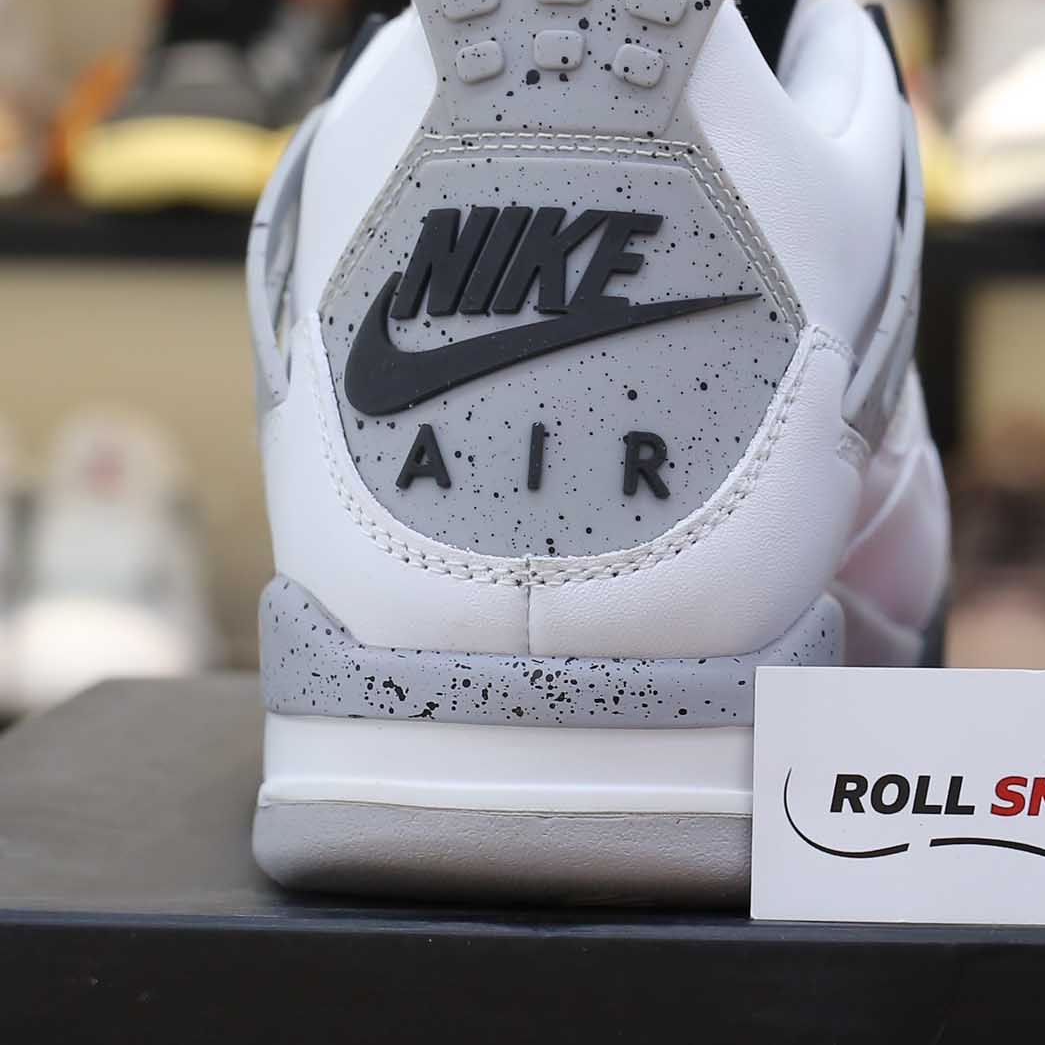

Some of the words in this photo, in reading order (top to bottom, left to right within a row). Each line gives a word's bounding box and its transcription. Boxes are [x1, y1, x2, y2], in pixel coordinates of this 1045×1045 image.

[390, 206, 663, 318] NIKE
[396, 423, 671, 499] AIR
[829, 773, 975, 815] ROLL
